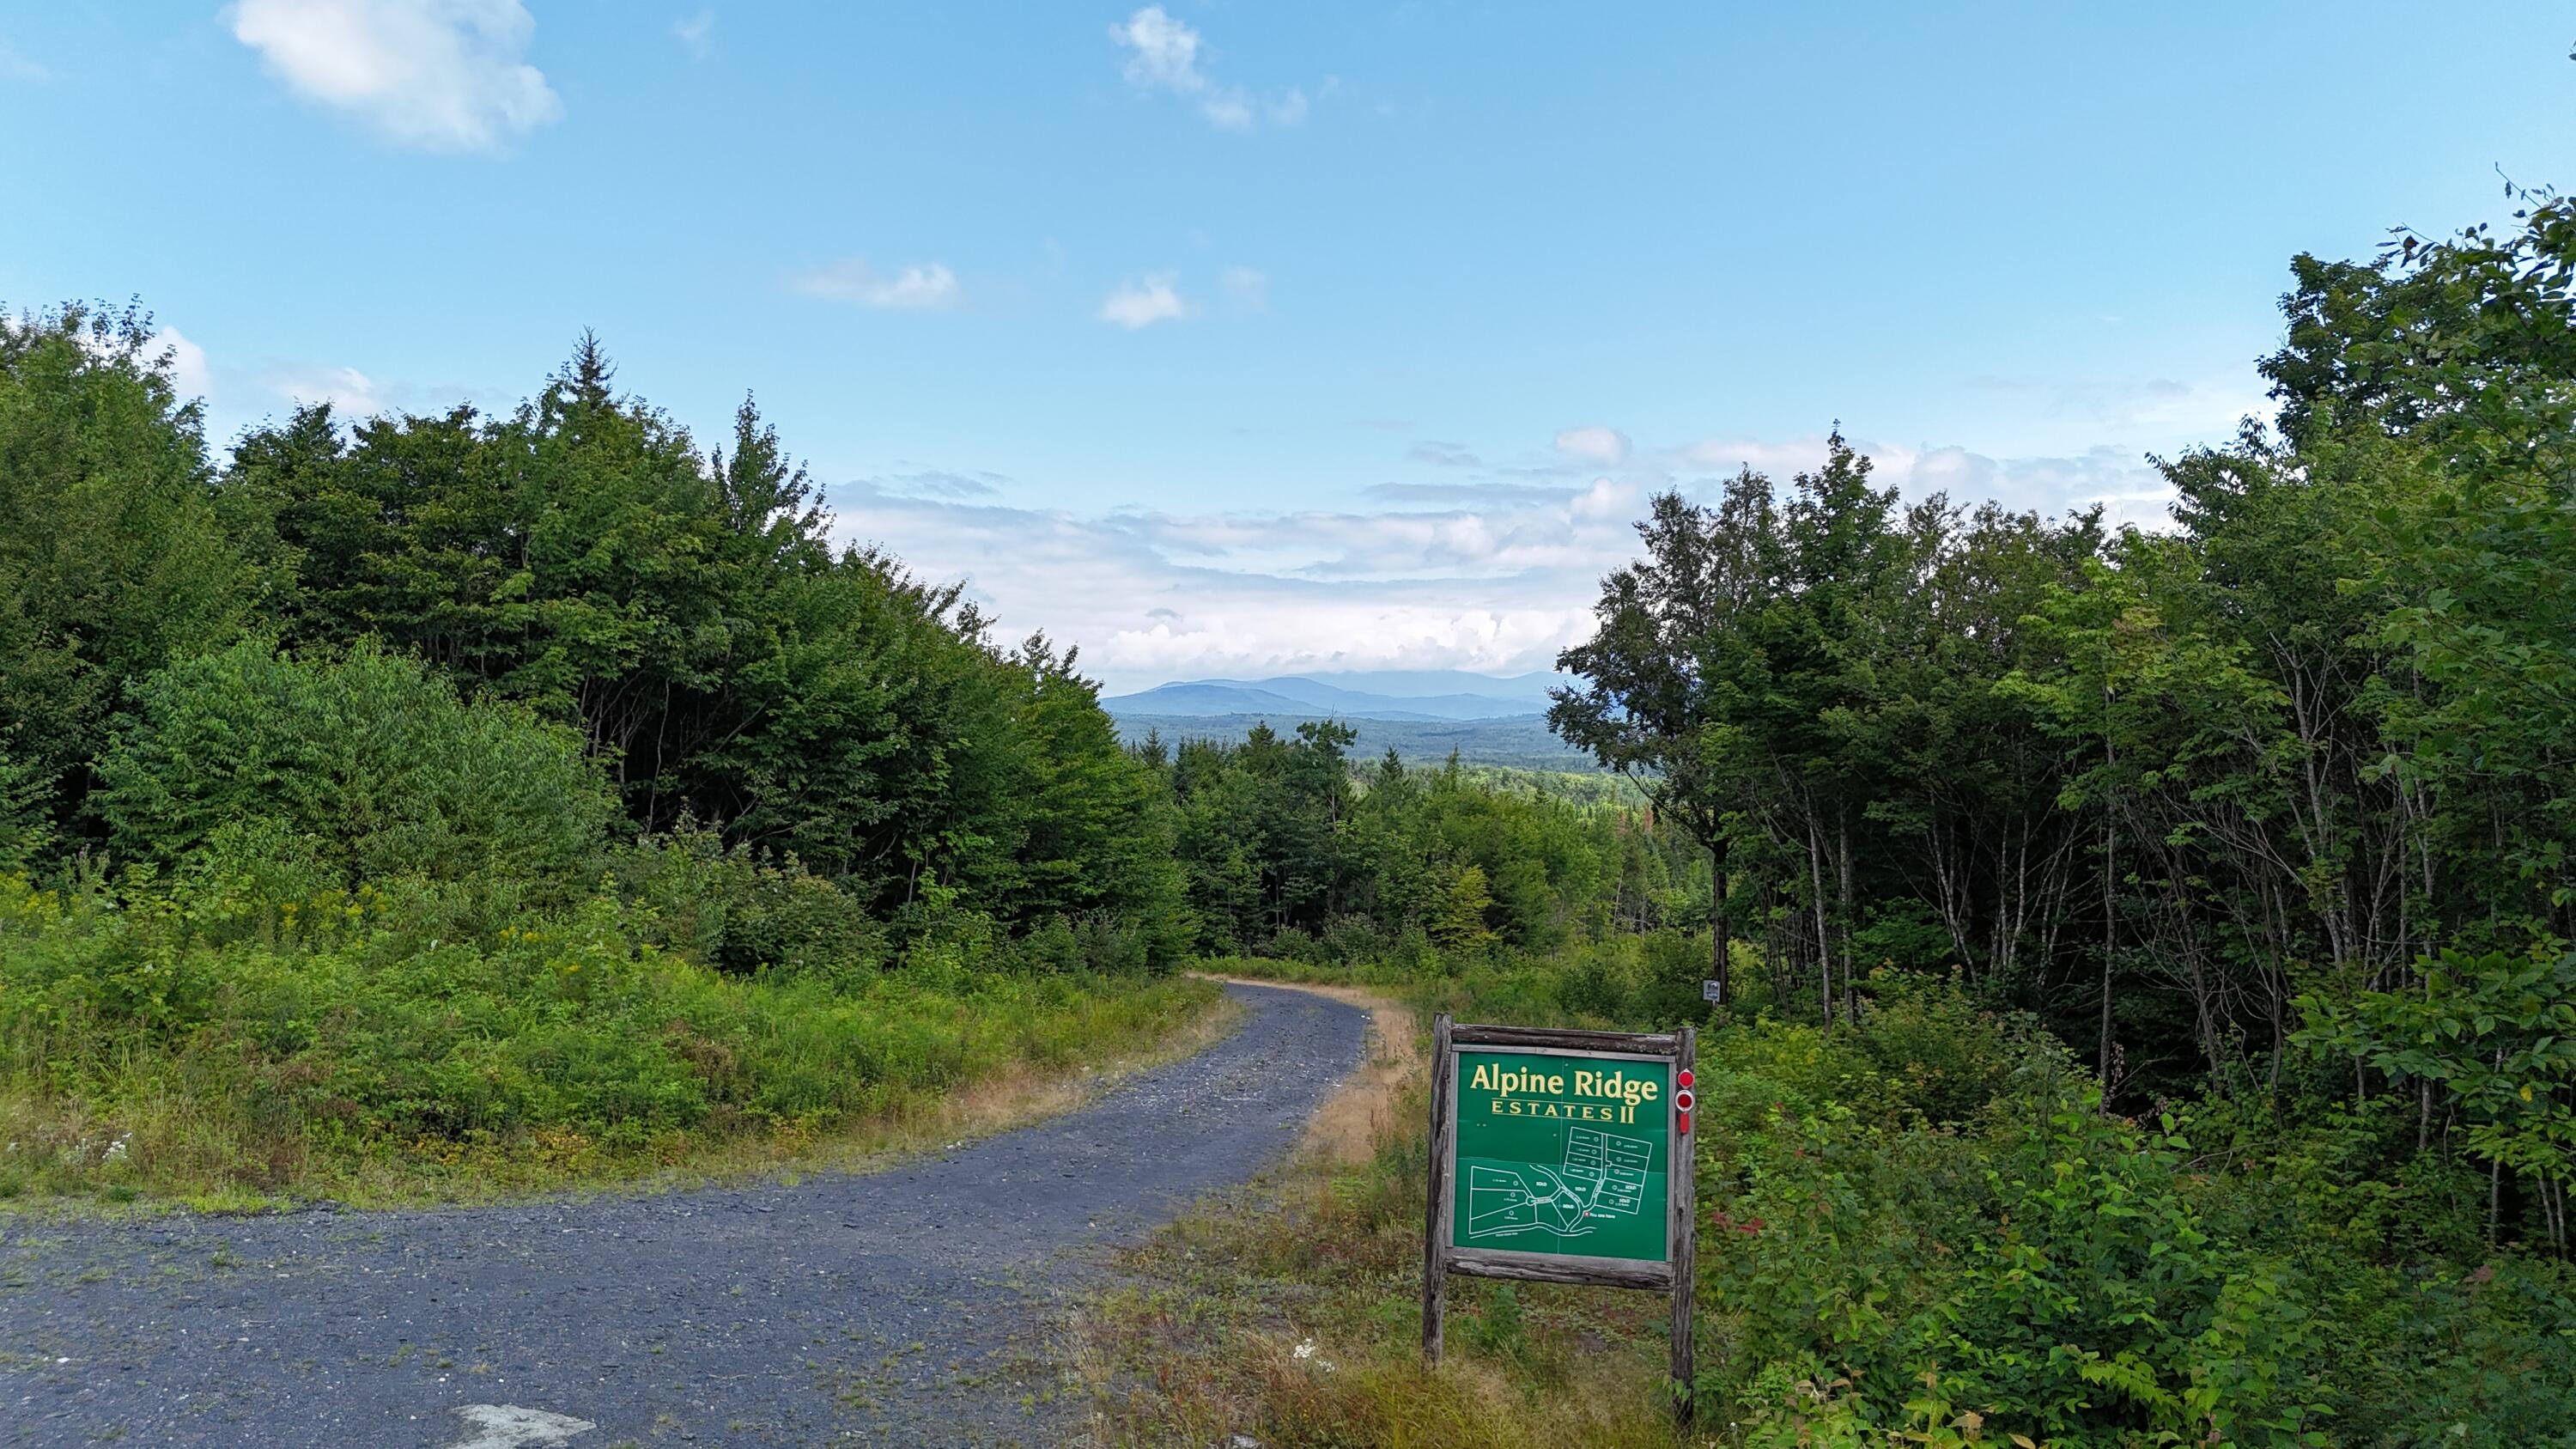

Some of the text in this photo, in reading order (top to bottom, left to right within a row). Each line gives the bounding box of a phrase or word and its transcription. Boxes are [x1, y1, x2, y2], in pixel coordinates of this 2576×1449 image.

[1470, 1062, 1658, 1106] Alpine Ridge
[1492, 1100, 1635, 1124] ESTATES II
